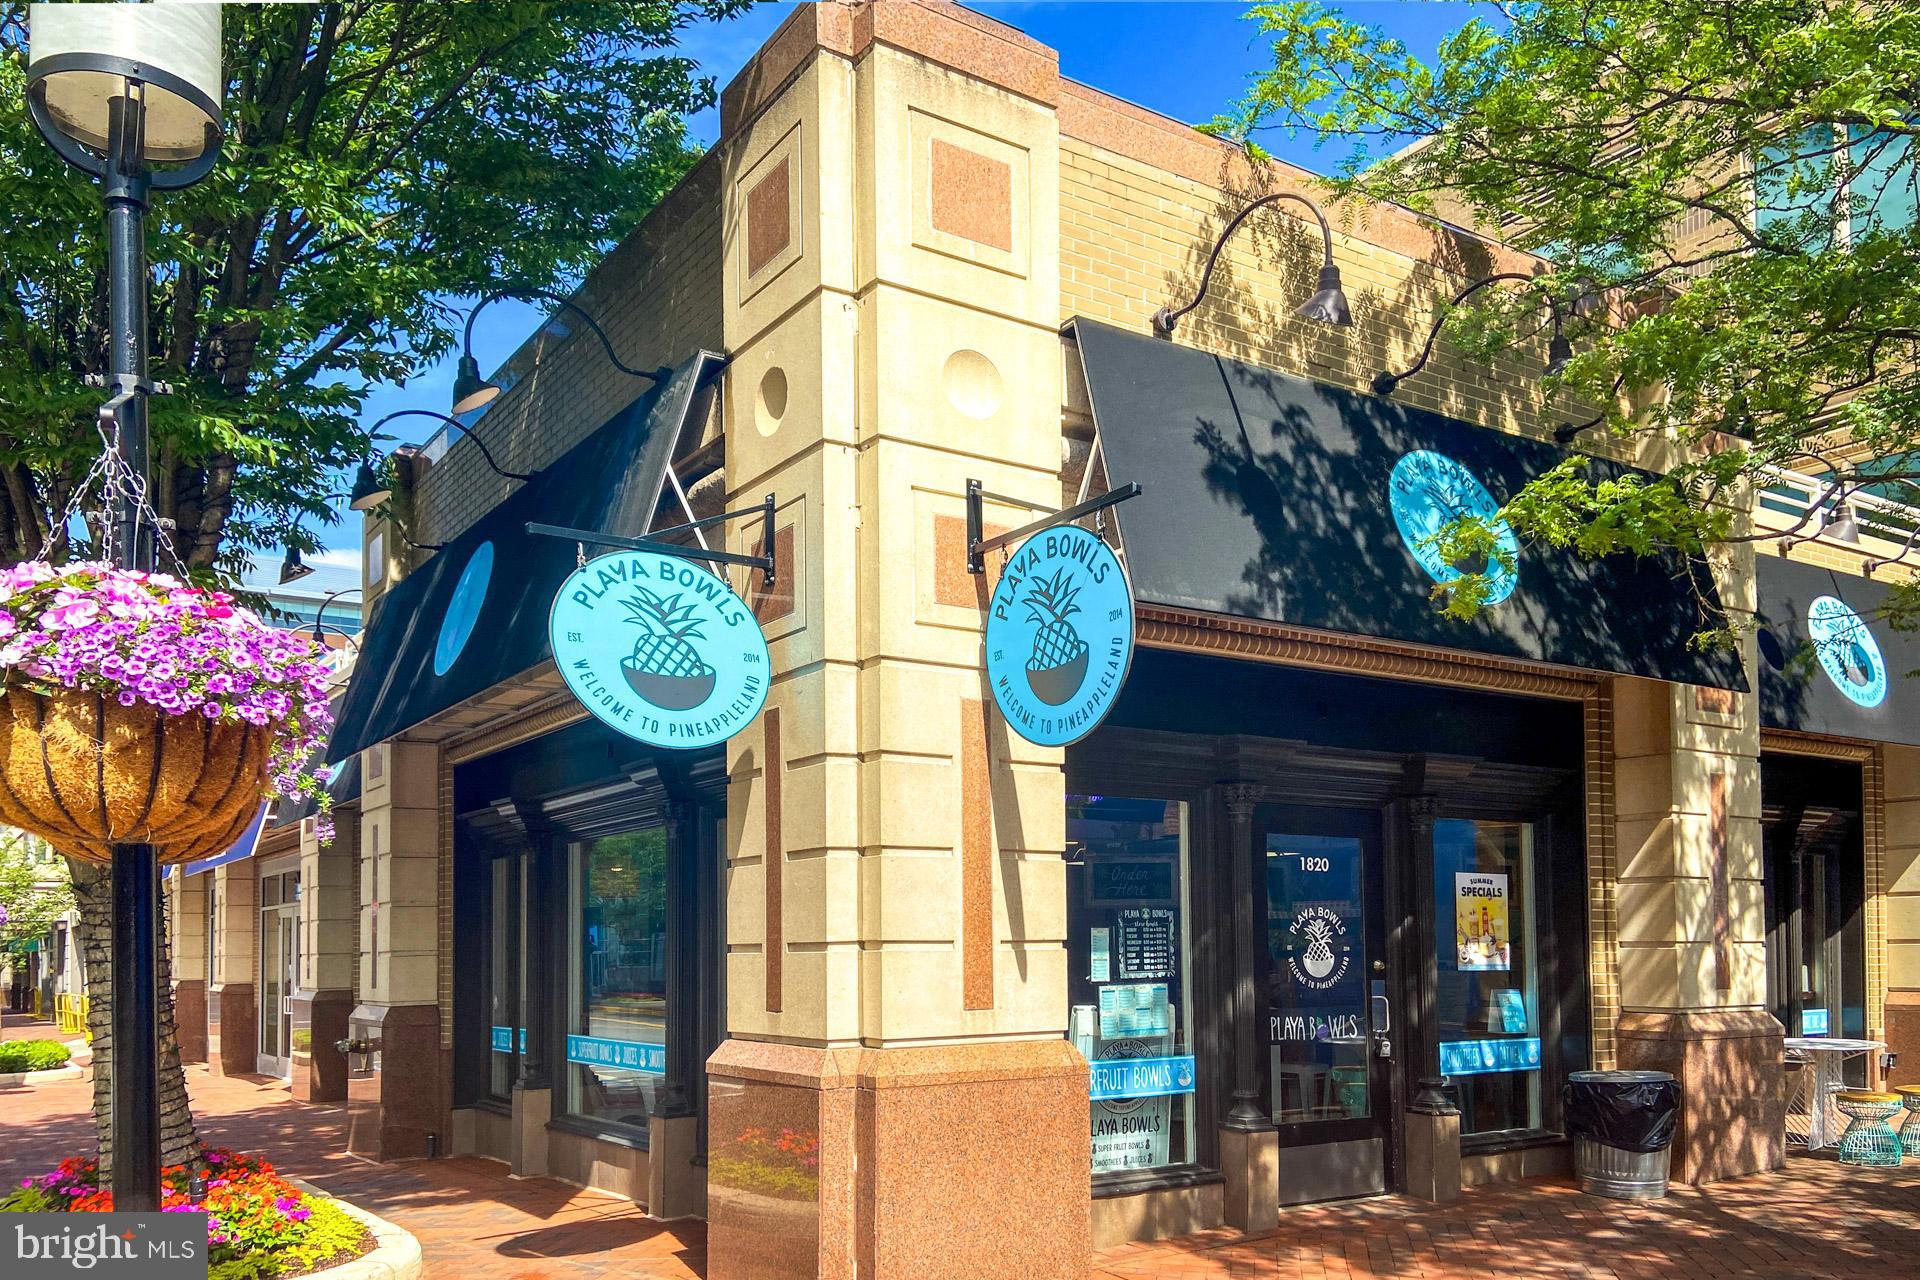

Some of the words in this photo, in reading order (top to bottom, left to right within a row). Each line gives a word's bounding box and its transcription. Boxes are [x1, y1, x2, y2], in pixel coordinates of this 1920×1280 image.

[1397, 460, 1434, 496] PLAYA
[1438, 460, 1494, 514] BOWLS
[995, 547, 1041, 621] PLAYA
[1046, 534, 1110, 584] BOWLS
[572, 559, 650, 610] PLAYA
[659, 560, 745, 627] BOWLS
[1109, 607, 1123, 622] 2014
[567, 631, 584, 643] EST.
[743, 652, 760, 664] 2014
[998, 674, 1034, 729] WELCOME
[1040, 718, 1052, 735] TO
[1058, 637, 1123, 734] PINEAPPLELAND
[573, 658, 634, 722] WELCOME
[642, 716, 659, 734] TO
[669, 675, 760, 738] PINEAPPLELAND
[1300, 856, 1329, 872] 1820
[1461, 886, 1503, 898] SPECIALS
[1289, 907, 1315, 935] PLAYA
[1317, 907, 1346, 935] BOWLS
[1288, 956, 1307, 985] WELCOME
[1308, 980, 1315, 989] TO
[1270, 1015, 1306, 1041] PLAYA
[1104, 1041, 1124, 1058] PLAYA
[1128, 1040, 1150, 1057] BOWLS
[1133, 1064, 1172, 1089] BOWLS
[1122, 1115, 1160, 1134] BOWLS
[1097, 1143, 1112, 1153] SUPER
[1113, 1142, 1127, 1151] FRUIT
[1128, 1141, 1144, 1150] BOWLS
[1095, 1158, 1122, 1167] SMOOTHIES
[1129, 1155, 1147, 1164] JUICES
